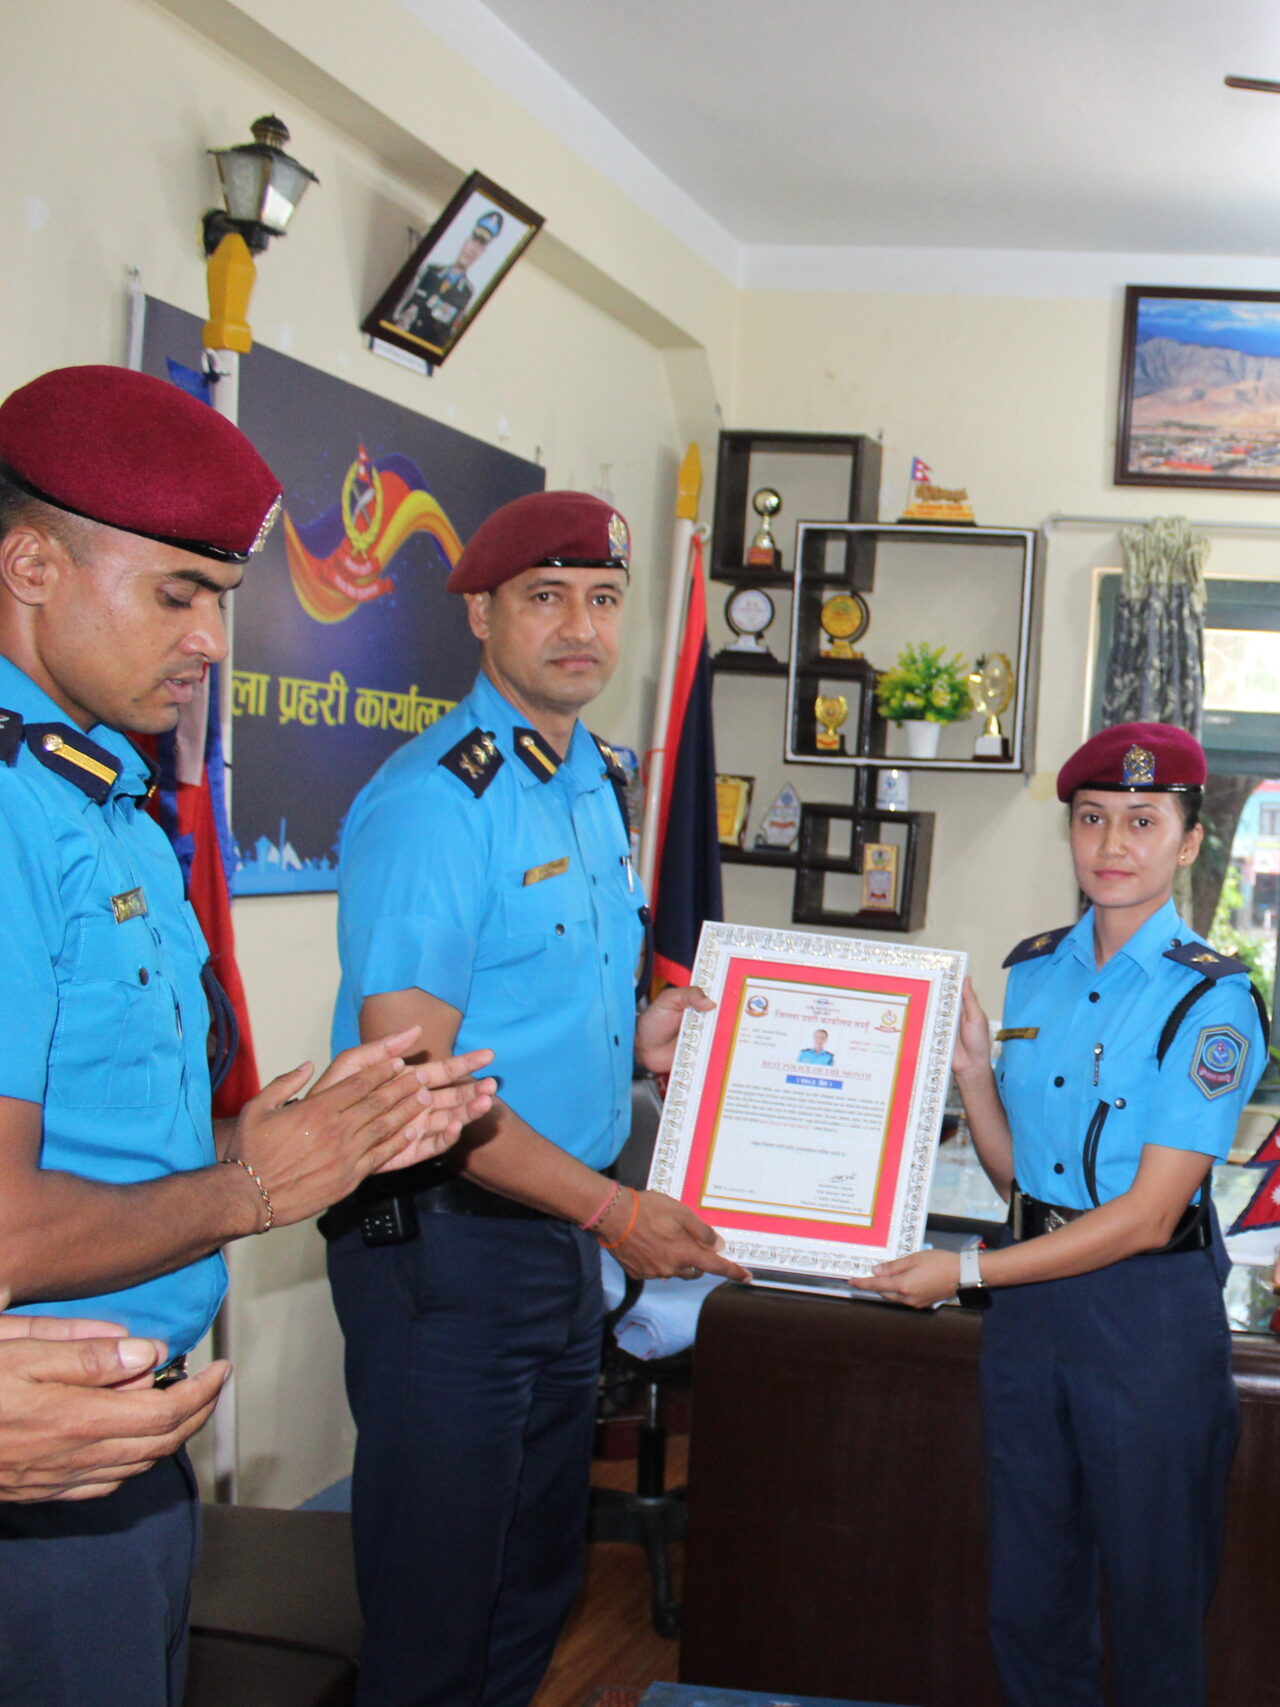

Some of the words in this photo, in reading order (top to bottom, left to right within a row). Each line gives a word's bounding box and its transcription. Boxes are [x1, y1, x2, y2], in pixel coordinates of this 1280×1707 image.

[278, 671, 349, 726] प्रहरी
[783, 1063, 811, 1072] POLICE
[843, 1070, 872, 1079] MONTH
